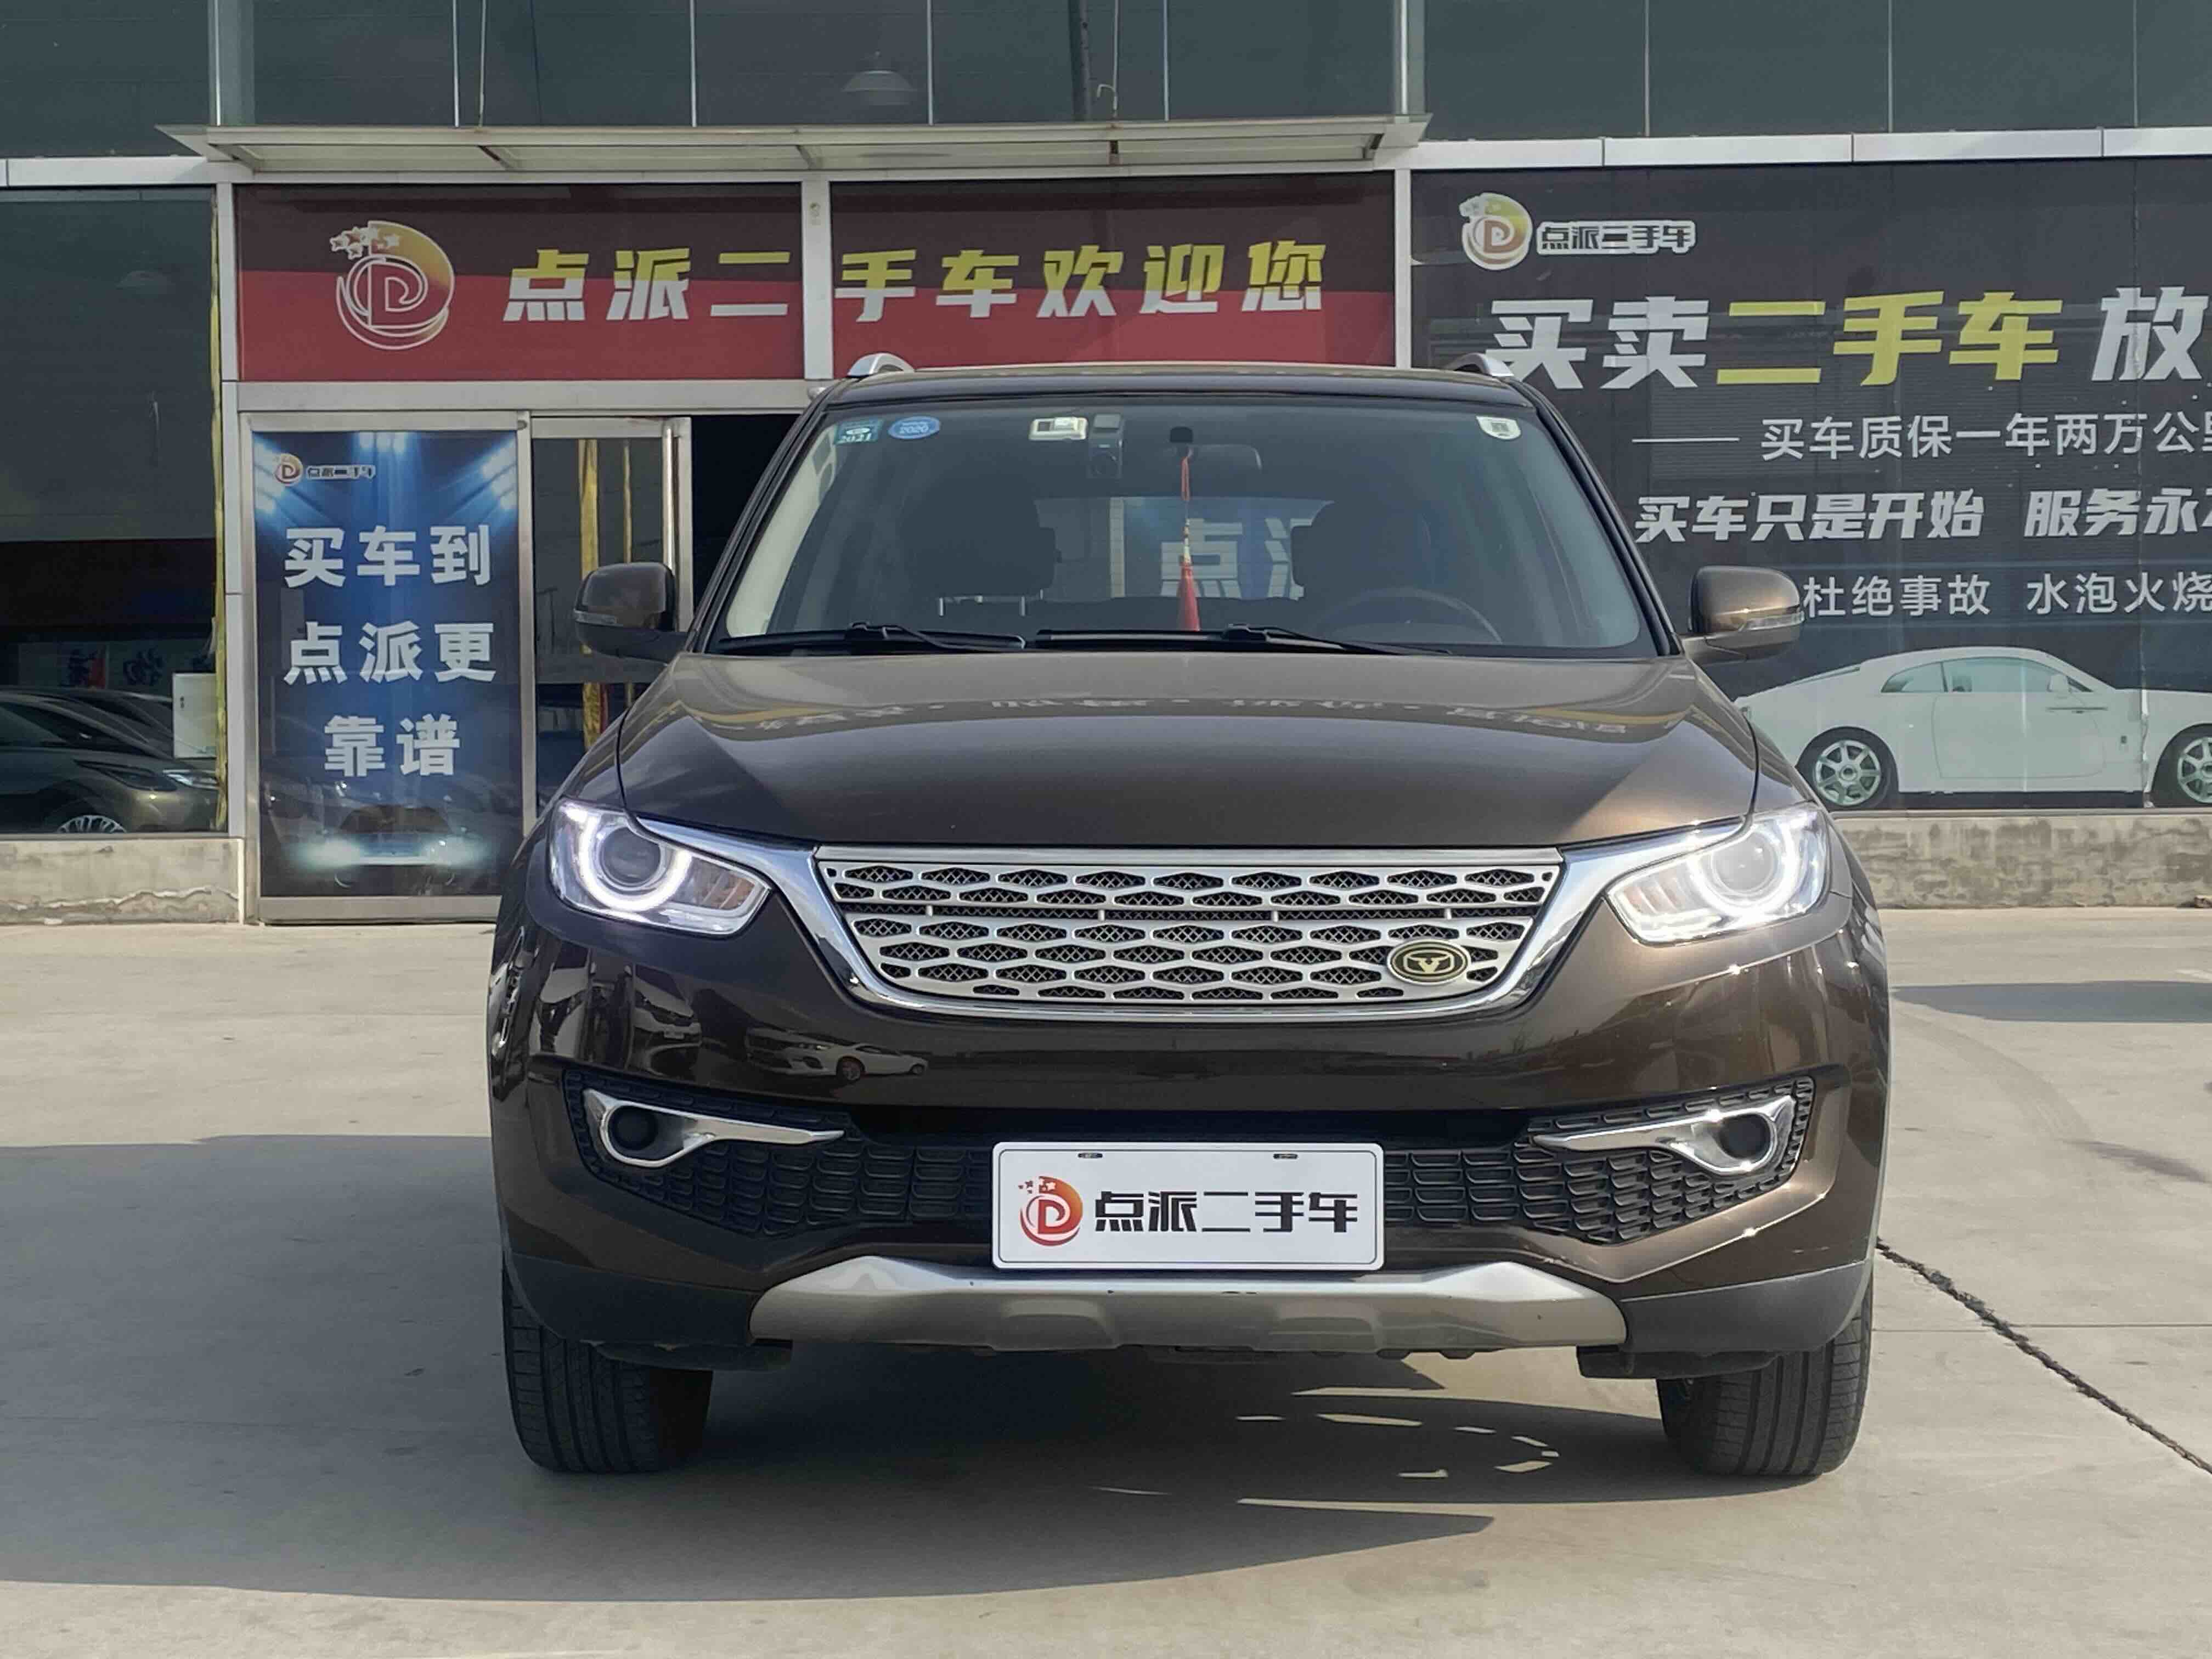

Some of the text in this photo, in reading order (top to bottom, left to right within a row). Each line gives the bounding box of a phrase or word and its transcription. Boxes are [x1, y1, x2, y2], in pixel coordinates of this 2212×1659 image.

[1542, 225, 1691, 250] 点派二手车
[503, 240, 1326, 322] 点派二手车欢迎您
[1485, 286, 2209, 390] 买卖二手车 放
[1760, 411, 2212, 461] 买车质保一年两万公
[1635, 487, 2212, 543] 买车只是开始 服务永
[284, 524, 492, 588] 买车到
[1803, 571, 2212, 617] 杜绝事故 水泡火烧
[283, 620, 496, 685] 点派更
[324, 713, 460, 777] 靠谱
[1095, 1190, 1358, 1233] 点派二手车
